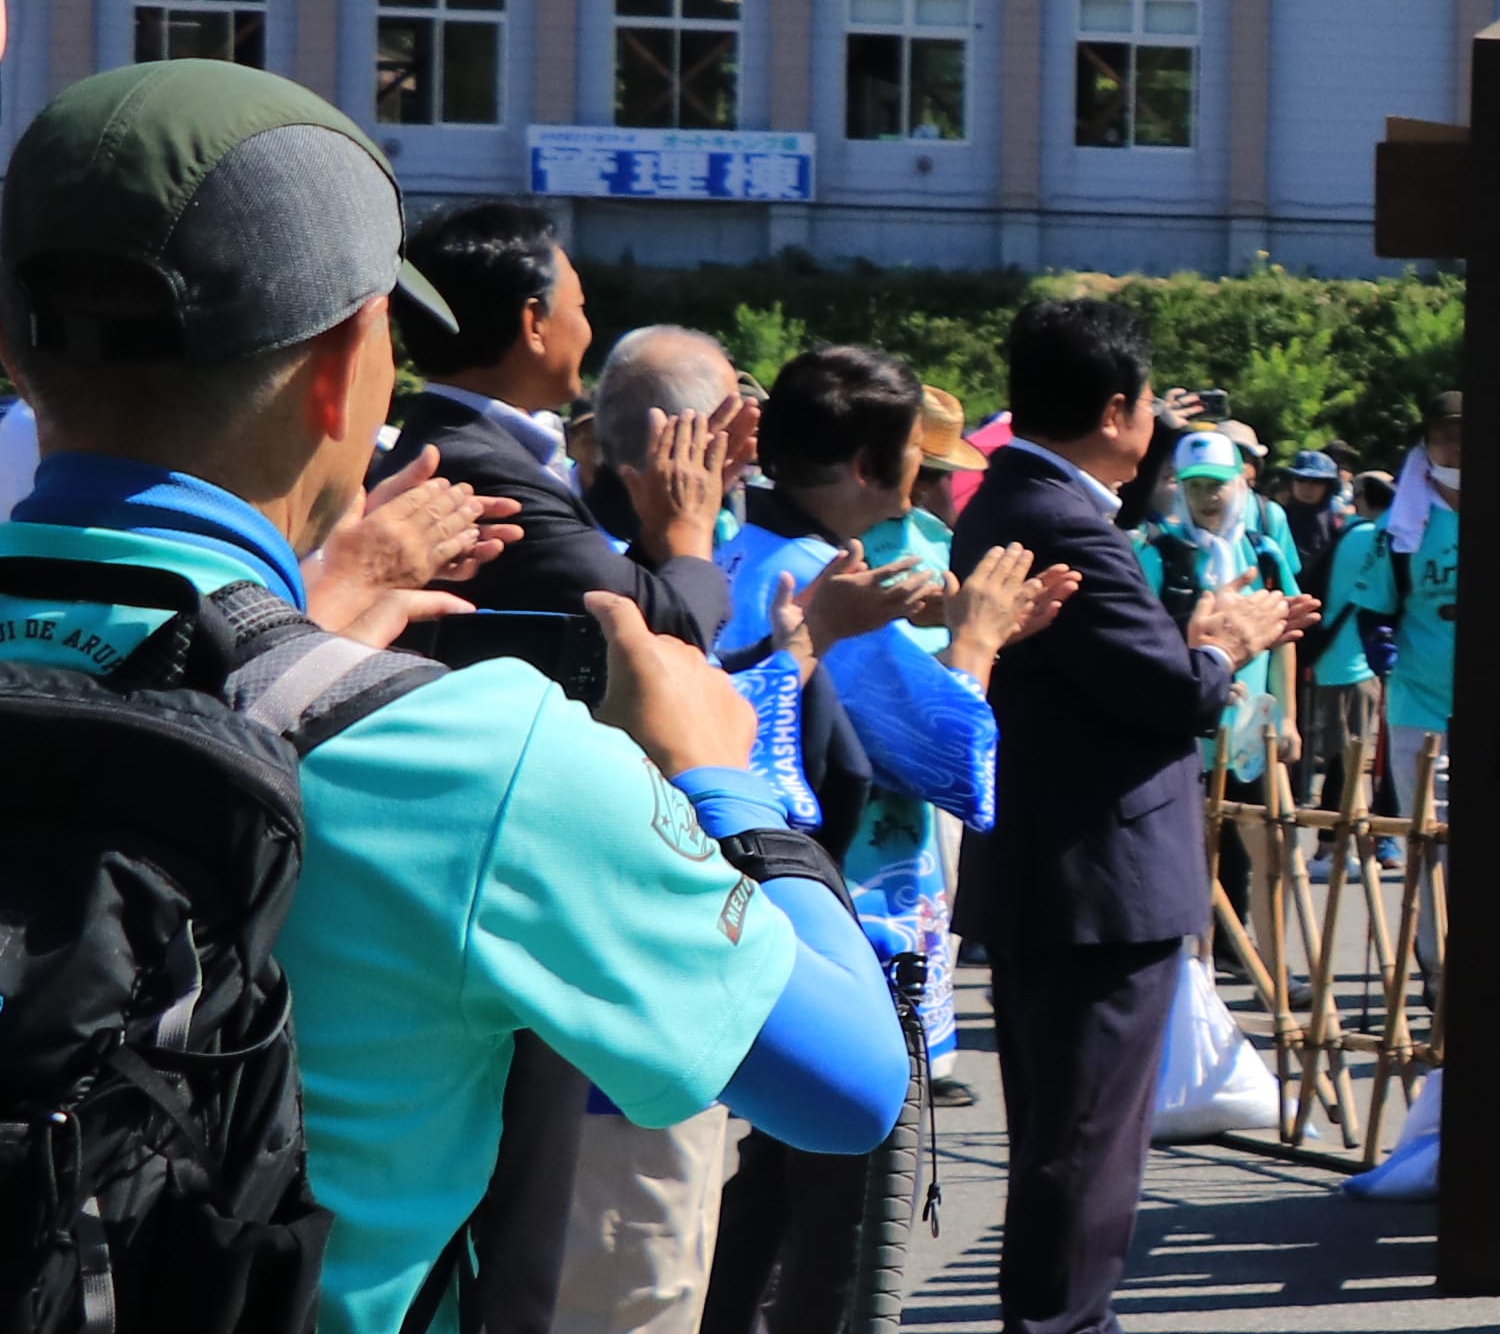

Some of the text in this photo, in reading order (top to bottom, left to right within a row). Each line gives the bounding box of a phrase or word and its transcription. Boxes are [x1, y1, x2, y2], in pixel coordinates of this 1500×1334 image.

[538, 148, 803, 197] 管理棟
[25, 618, 57, 641] DE
